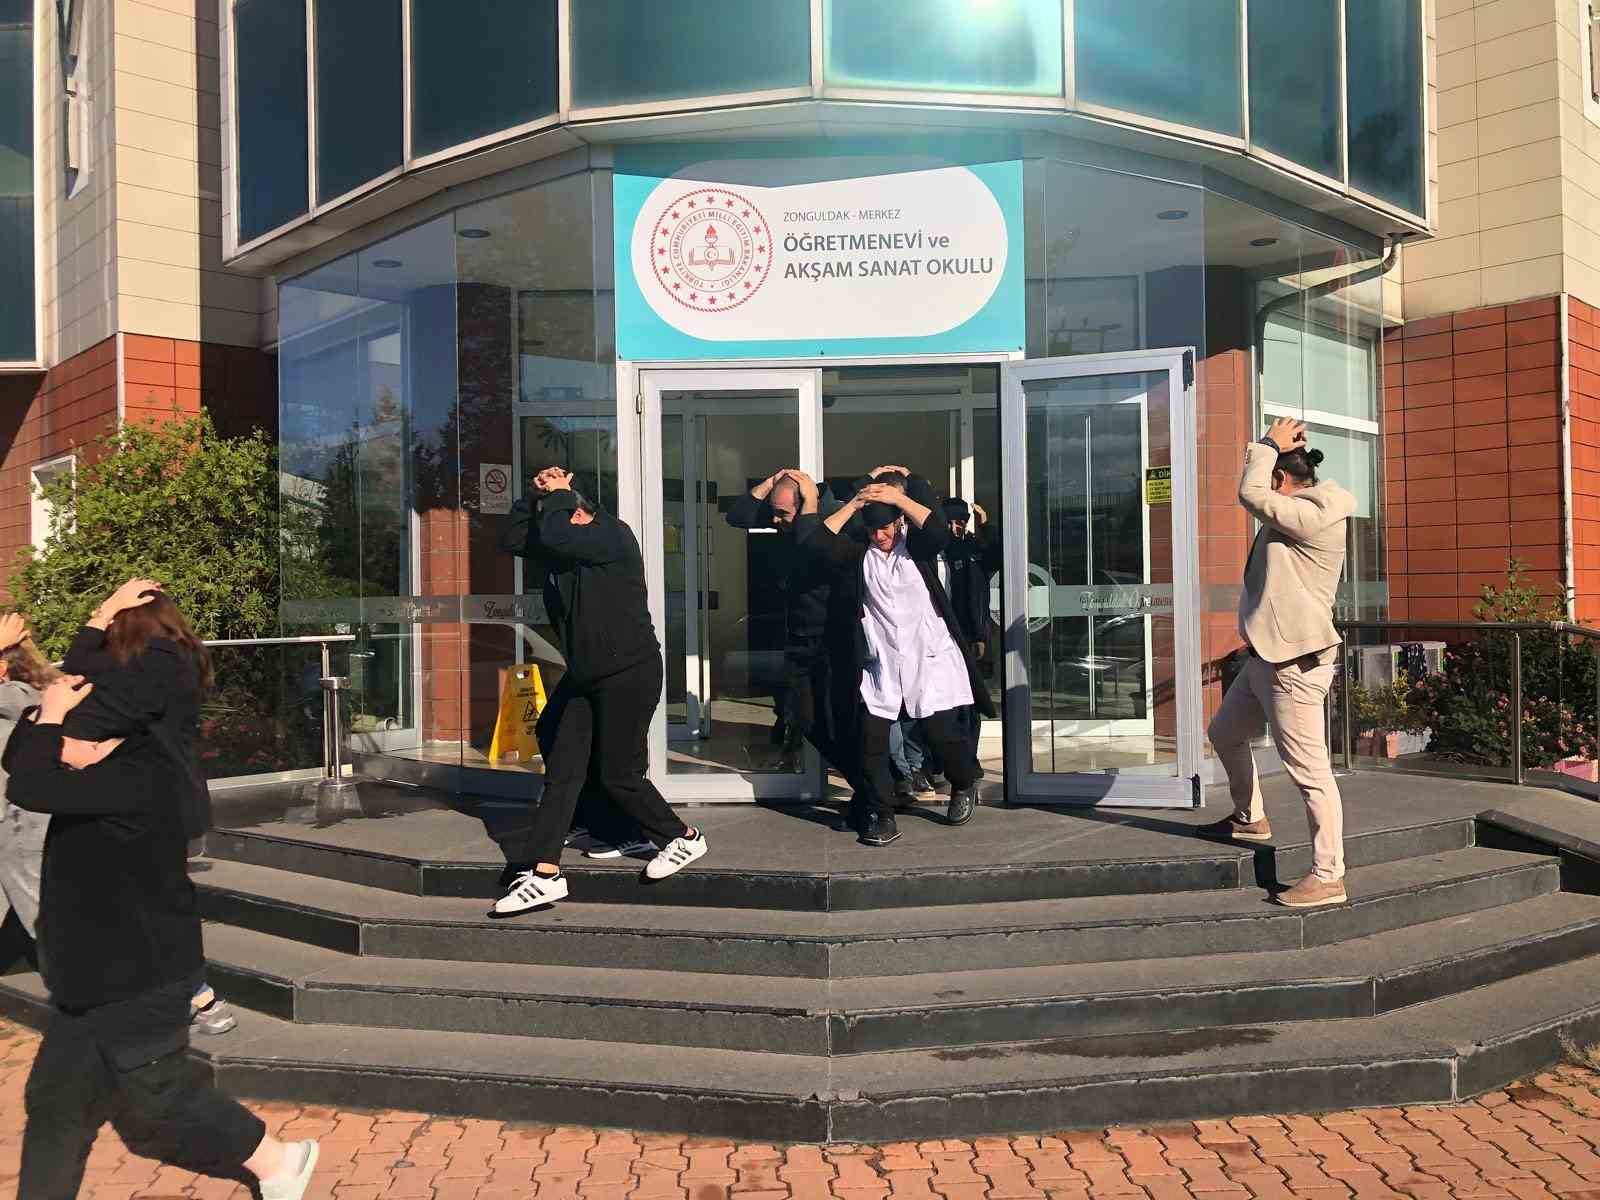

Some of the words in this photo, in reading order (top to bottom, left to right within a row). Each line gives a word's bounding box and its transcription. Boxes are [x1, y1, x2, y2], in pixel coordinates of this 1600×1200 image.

[783, 211, 850, 222] ZONGULDAK
[859, 209, 901, 220] MERKEZ
[783, 230, 922, 252] ÖĞRETMENEVİ
[927, 236, 950, 248] ve
[783, 261, 853, 282] AKŞAM
[858, 259, 921, 277] SANAT
[926, 257, 993, 275] OKULU
